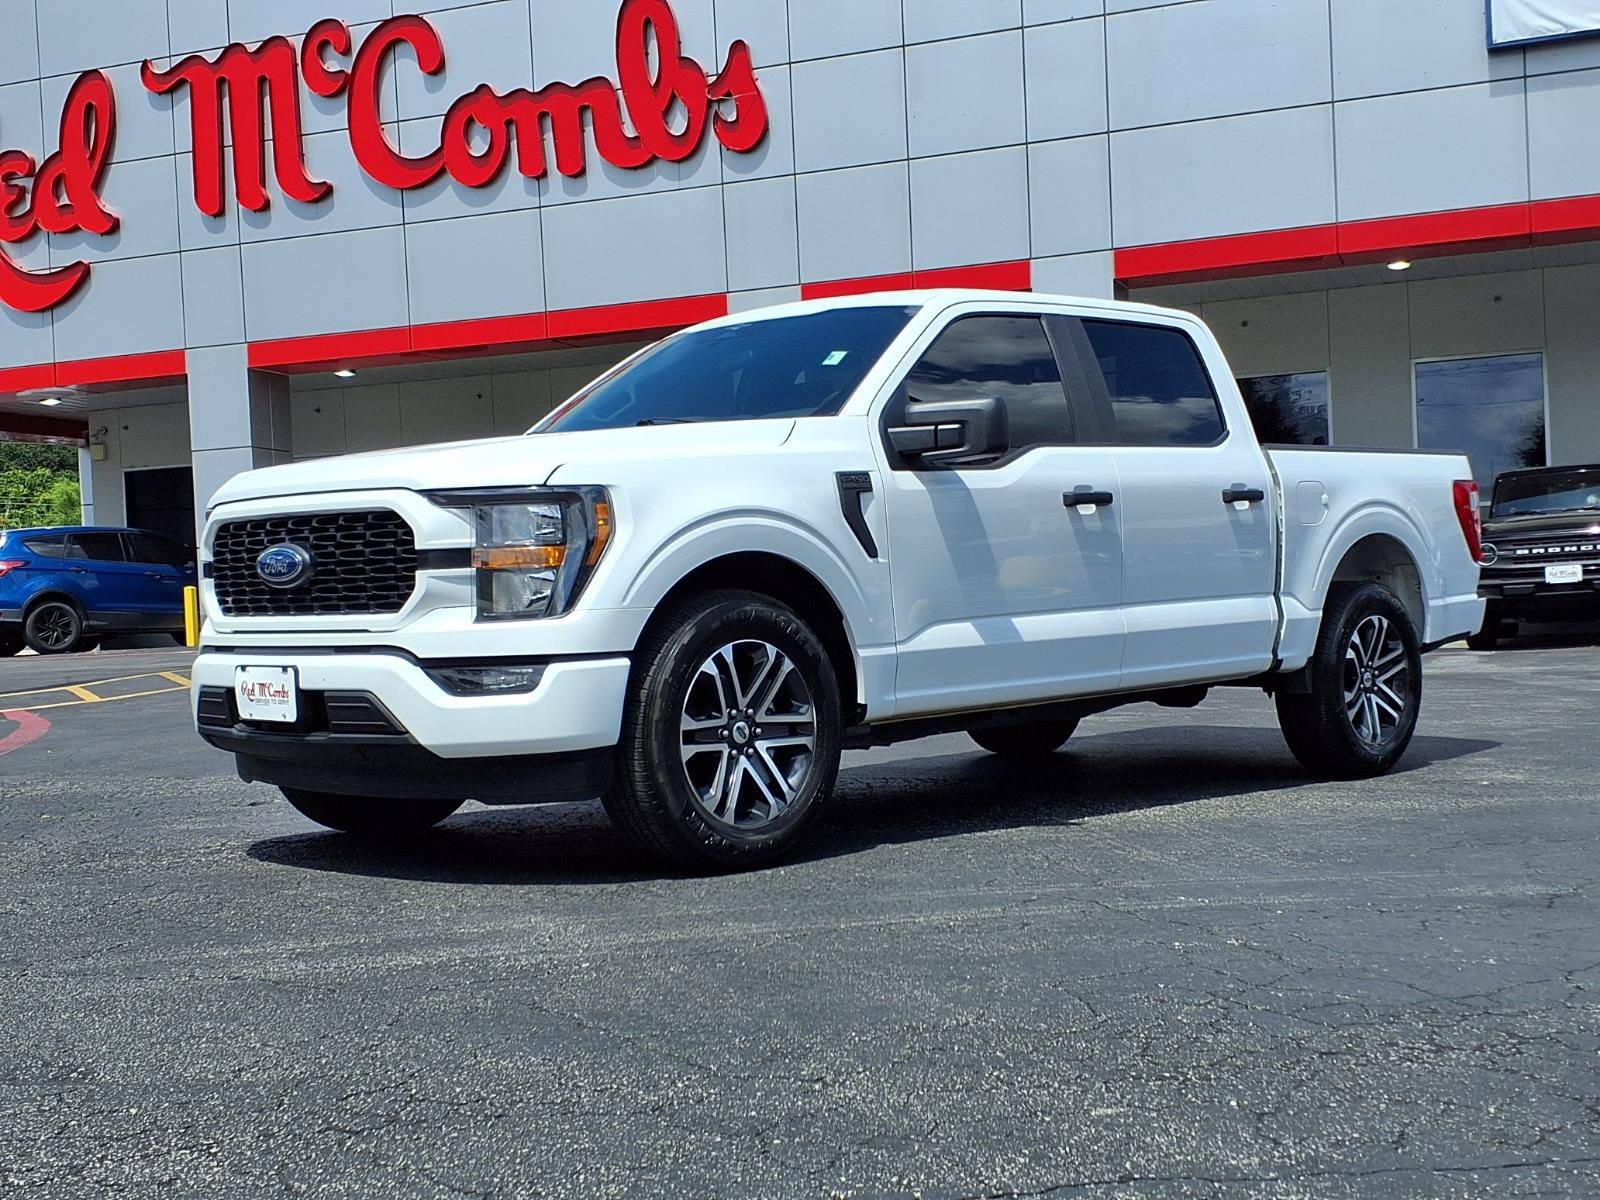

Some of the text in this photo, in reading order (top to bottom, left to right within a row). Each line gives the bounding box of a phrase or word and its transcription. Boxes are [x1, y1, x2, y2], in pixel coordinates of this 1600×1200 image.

[0, 0, 769, 312] ed McCombs
[1516, 545, 1600, 554] BRONC
[264, 555, 289, 574] Ford
[241, 681, 289, 702] Red McCombs
